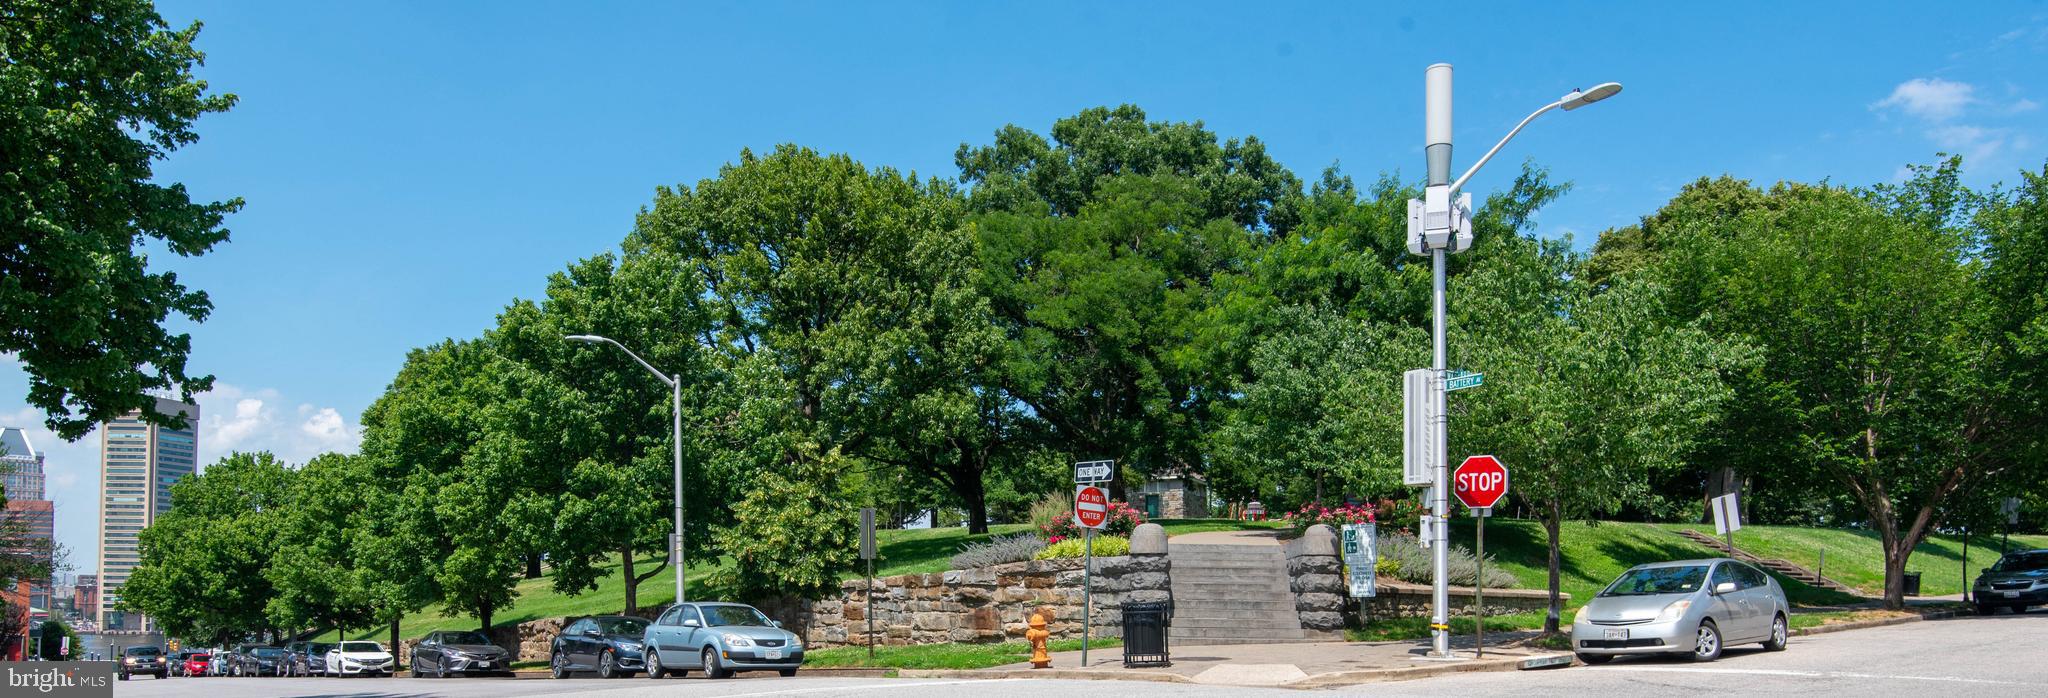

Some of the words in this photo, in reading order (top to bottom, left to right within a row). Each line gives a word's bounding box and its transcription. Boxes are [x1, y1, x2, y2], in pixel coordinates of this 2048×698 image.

[1449, 376, 1474, 389] BATTERY
[1458, 472, 1502, 492] STOP
[1082, 512, 1100, 520] ENTER
